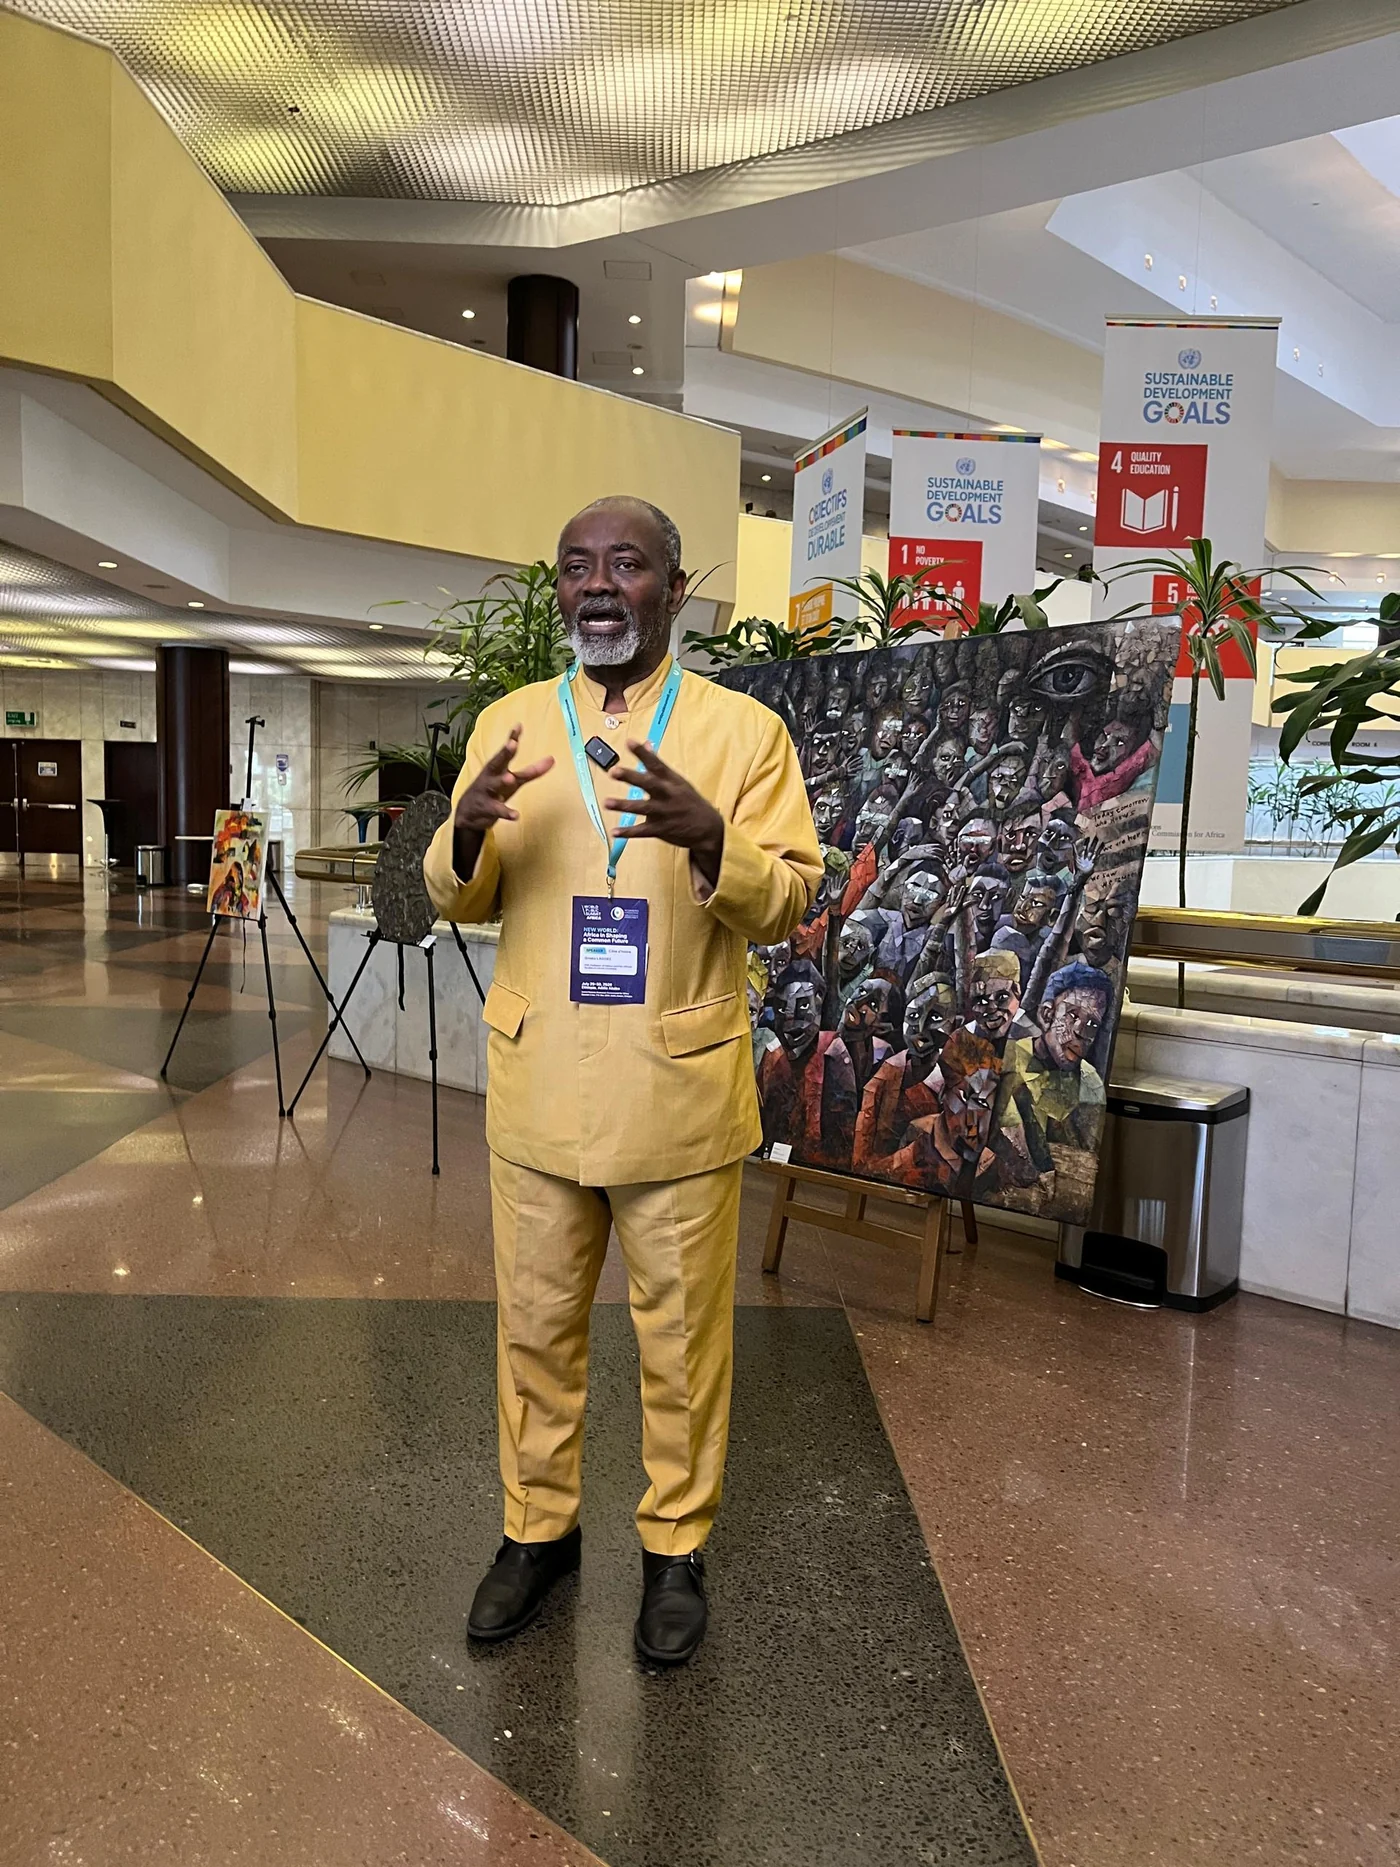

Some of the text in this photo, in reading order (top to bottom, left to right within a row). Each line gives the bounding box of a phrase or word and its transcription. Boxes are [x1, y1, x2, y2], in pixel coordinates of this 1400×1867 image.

[1145, 373, 1233, 386] SUSTAINABLE
[1144, 388, 1232, 400] DEVELOPMENT
[1143, 401, 1230, 424] GOALS
[1111, 451, 1122, 473] 4
[1131, 452, 1161, 462] QUALITY
[1130, 465, 1170, 475] EDUCATION
[928, 477, 1003, 491] SUSTAINABLE
[927, 490, 1002, 503] DEVELOPMENT
[809, 489, 847, 525] OBJECTIFS
[926, 502, 1001, 524] GOALS
[808, 525, 845, 561] DURABLE
[916, 545, 925, 554] NO
[902, 544, 908, 565] 1
[915, 556, 944, 566] POVERTY
[1168, 583, 1178, 603] 5
